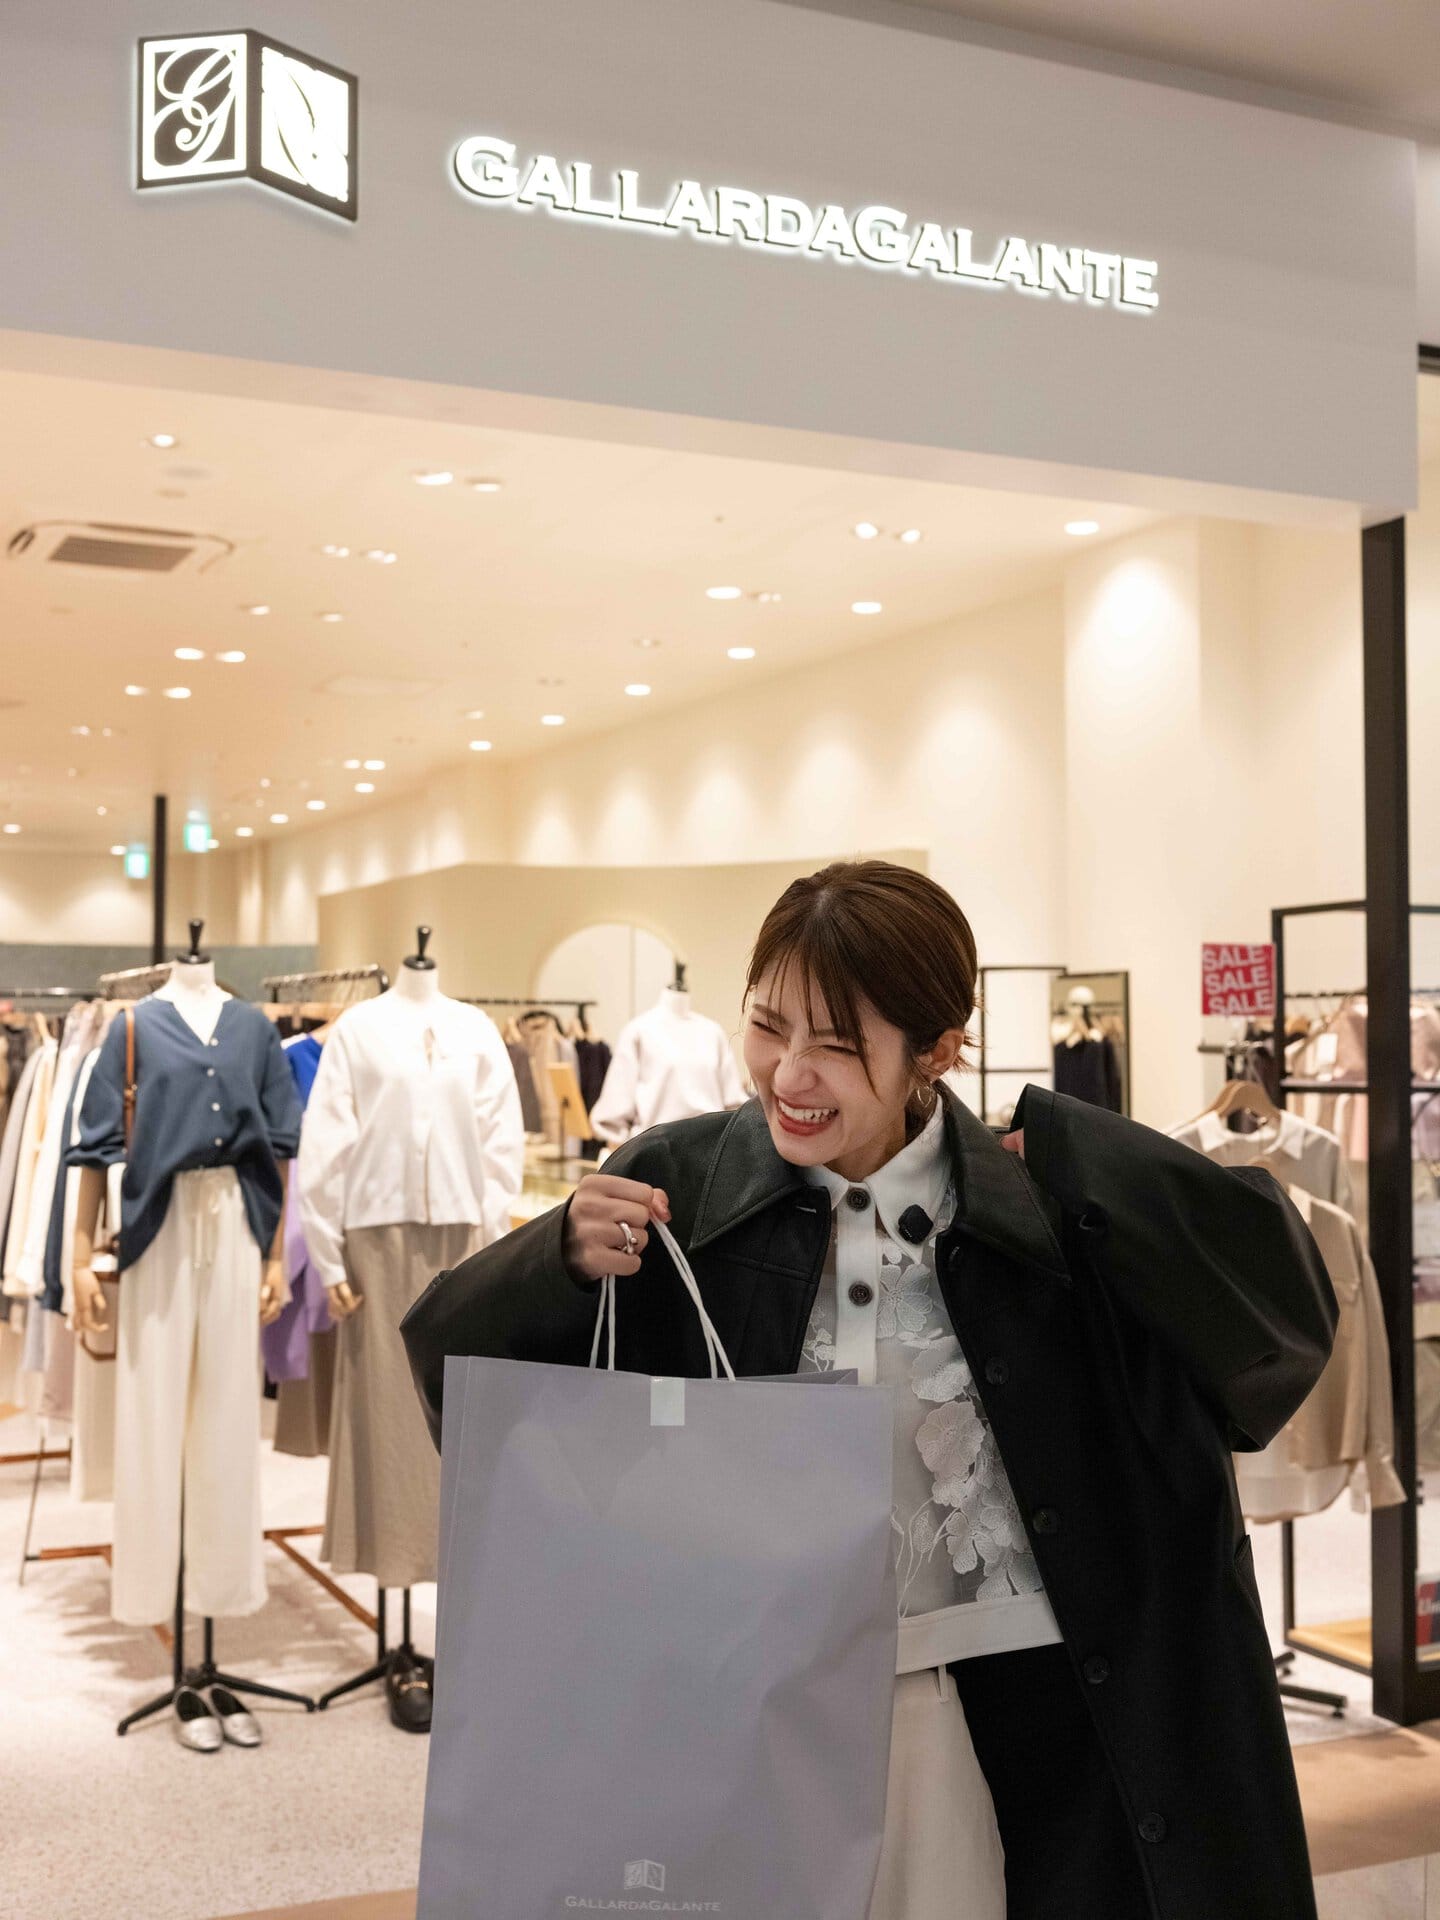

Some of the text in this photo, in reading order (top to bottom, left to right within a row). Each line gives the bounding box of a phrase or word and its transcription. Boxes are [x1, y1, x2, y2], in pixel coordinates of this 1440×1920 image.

[453, 135, 1159, 307] GALLARDAGALANTE
[1202, 944, 1266, 972] SALE
[1205, 966, 1269, 995] SALE
[1208, 989, 1274, 1016] SALE
[564, 1896, 721, 1912] GALLARDAGALANTE
